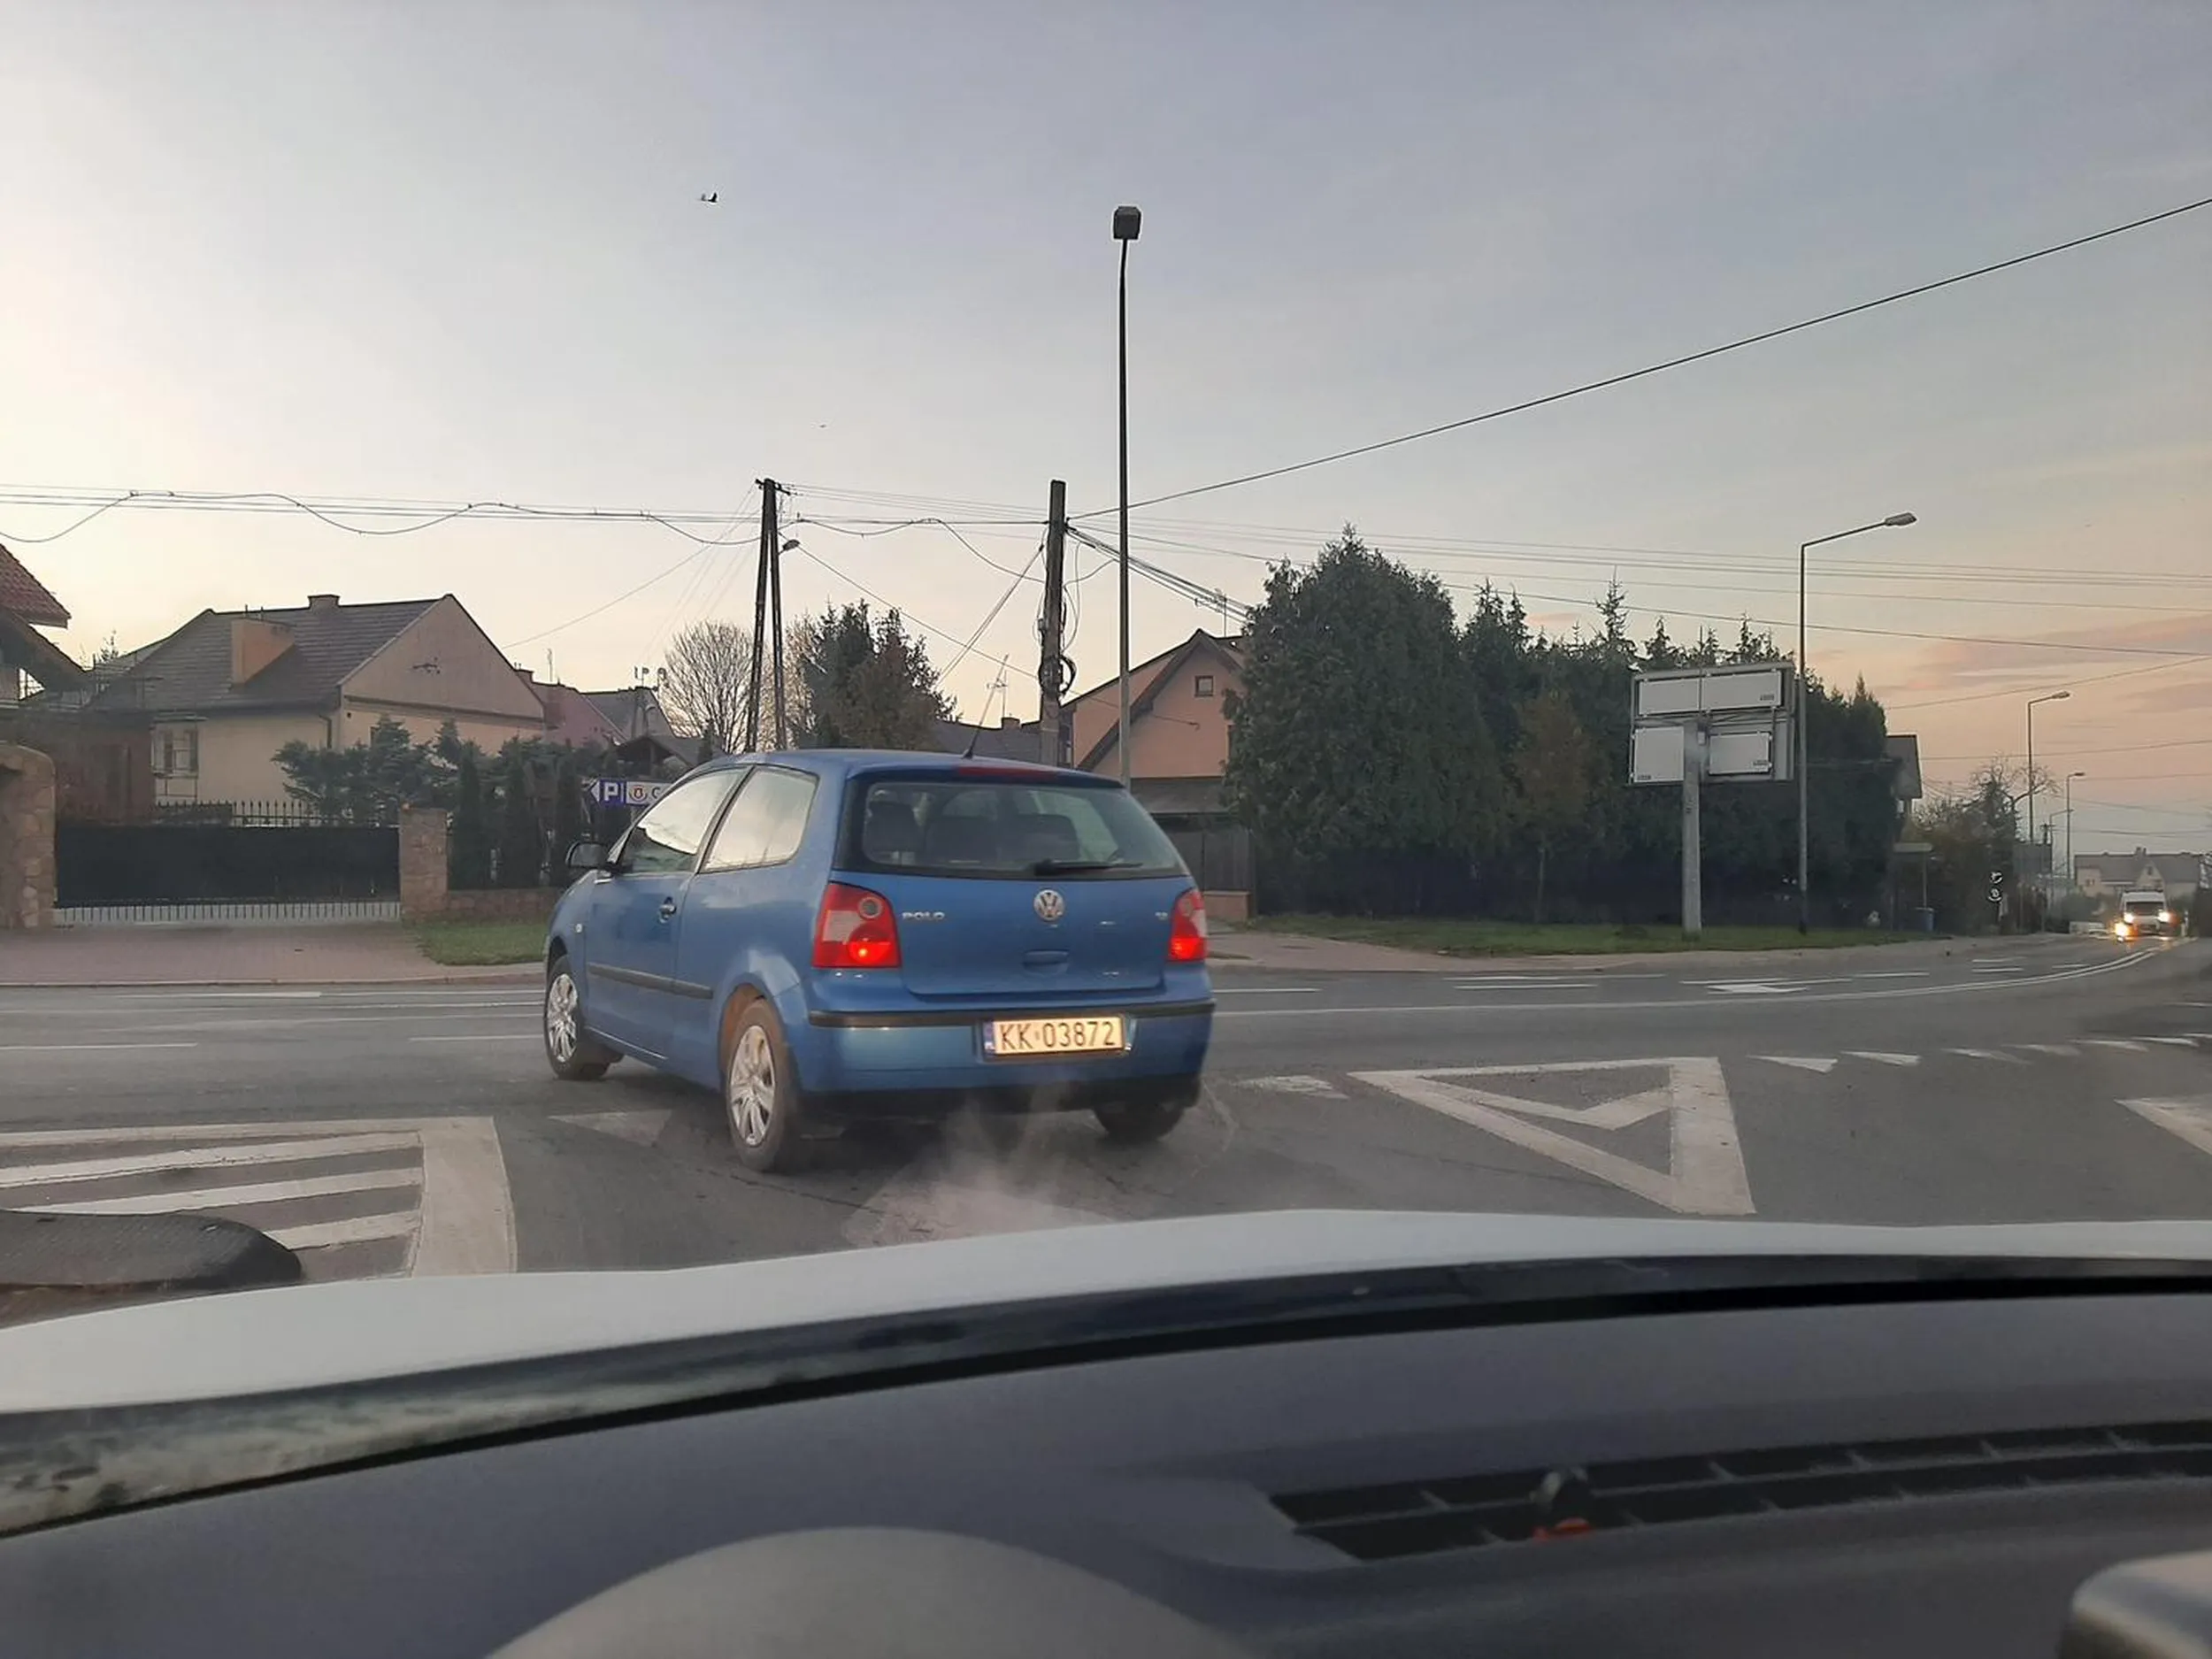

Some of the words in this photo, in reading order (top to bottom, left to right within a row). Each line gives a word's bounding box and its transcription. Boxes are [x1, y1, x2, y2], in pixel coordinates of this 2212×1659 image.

[603, 781, 619, 801] P
[999, 1023, 1033, 1050] KK
[1042, 1020, 1116, 1048] 03872
